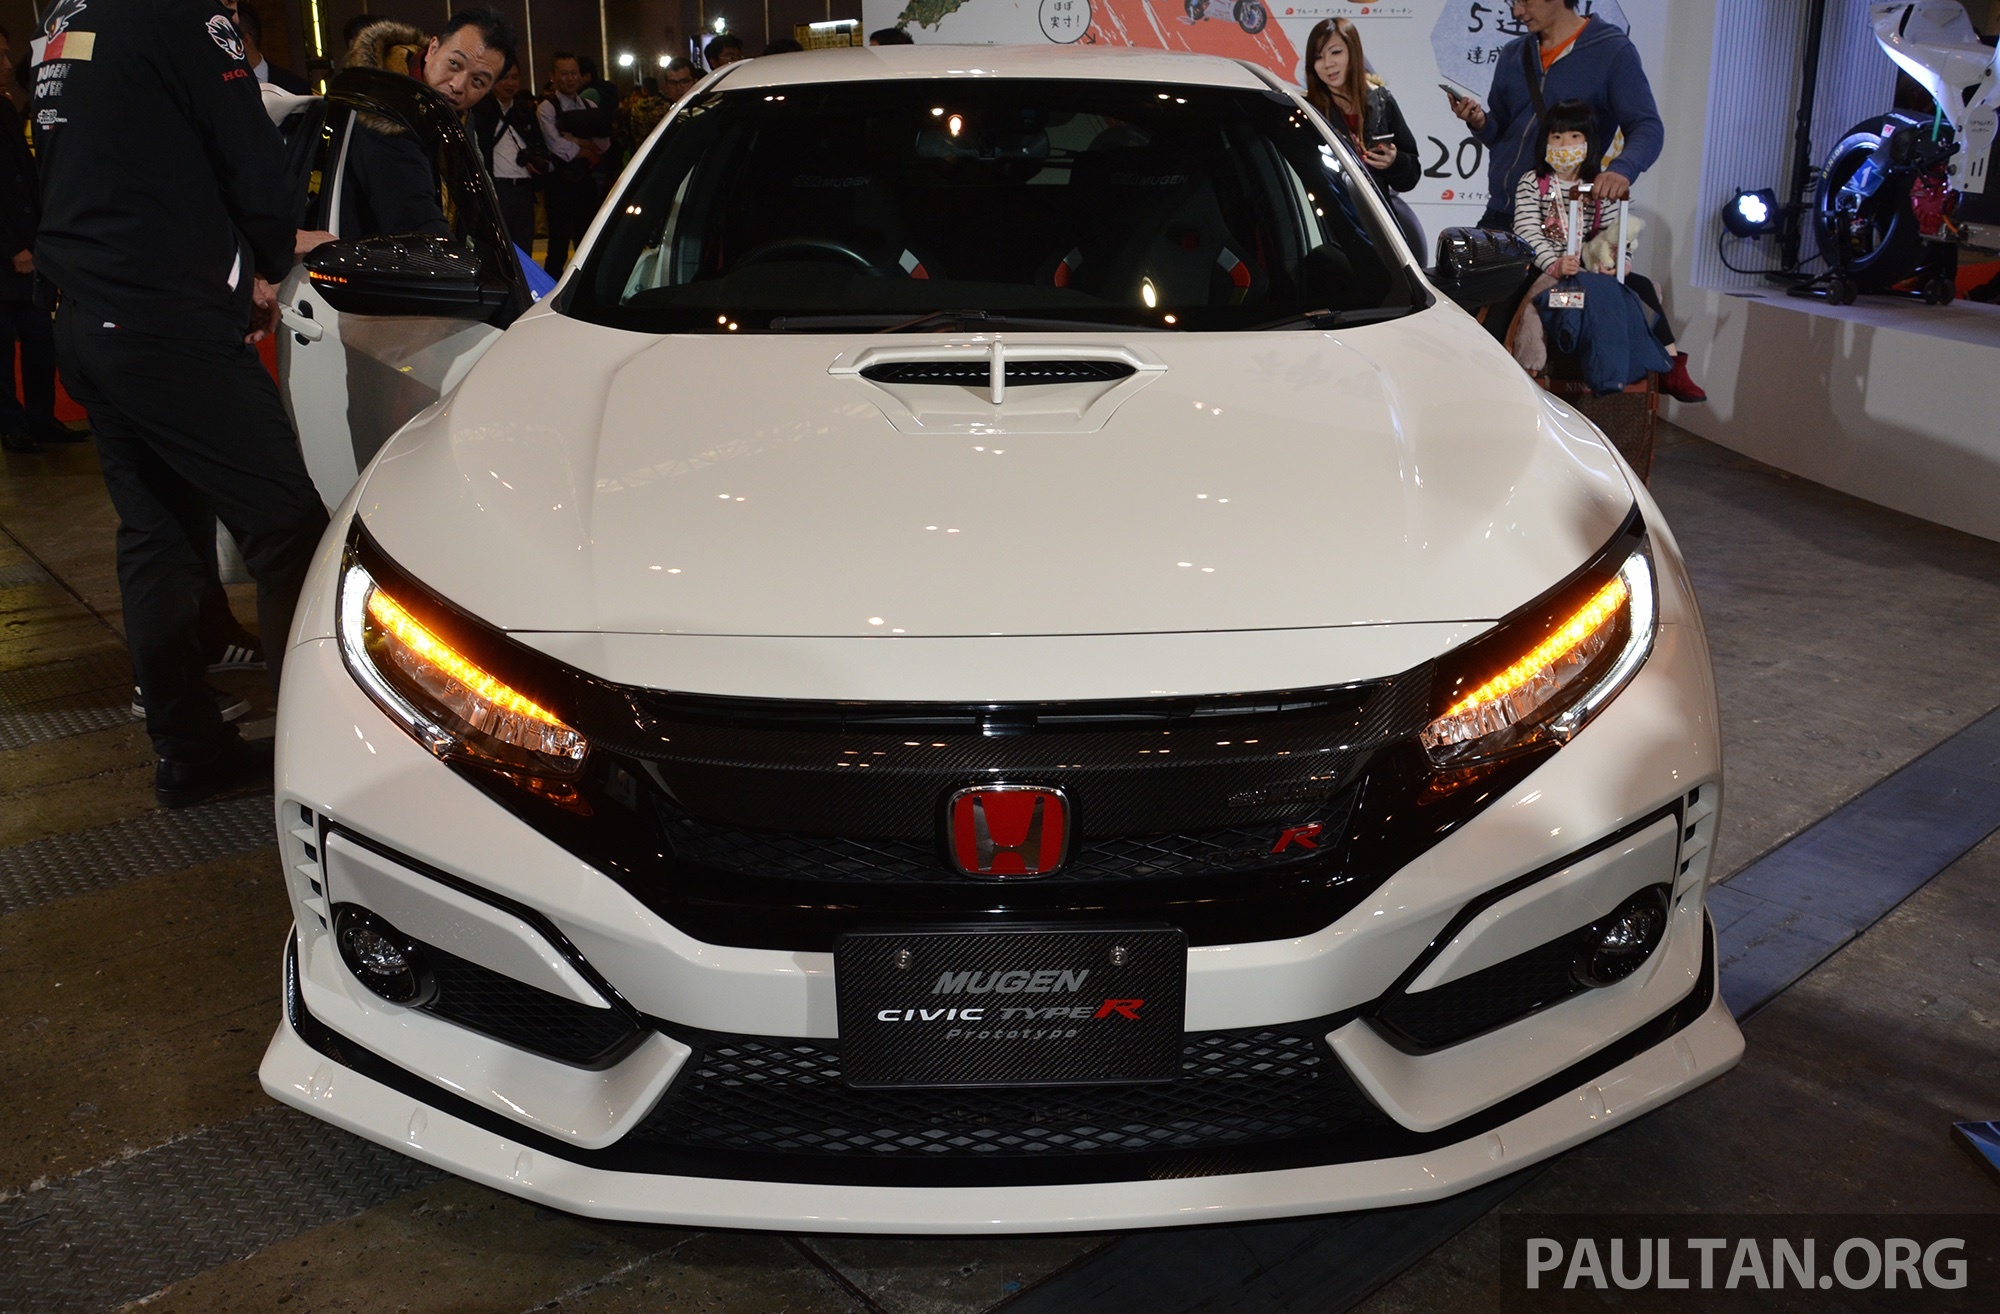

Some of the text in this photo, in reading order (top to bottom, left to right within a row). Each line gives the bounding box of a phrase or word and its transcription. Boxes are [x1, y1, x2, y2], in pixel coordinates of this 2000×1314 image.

[931, 969, 1090, 995] MUGEN
[877, 1008, 985, 1022] CIVIC
[946, 1026, 1079, 1040] Prototype
